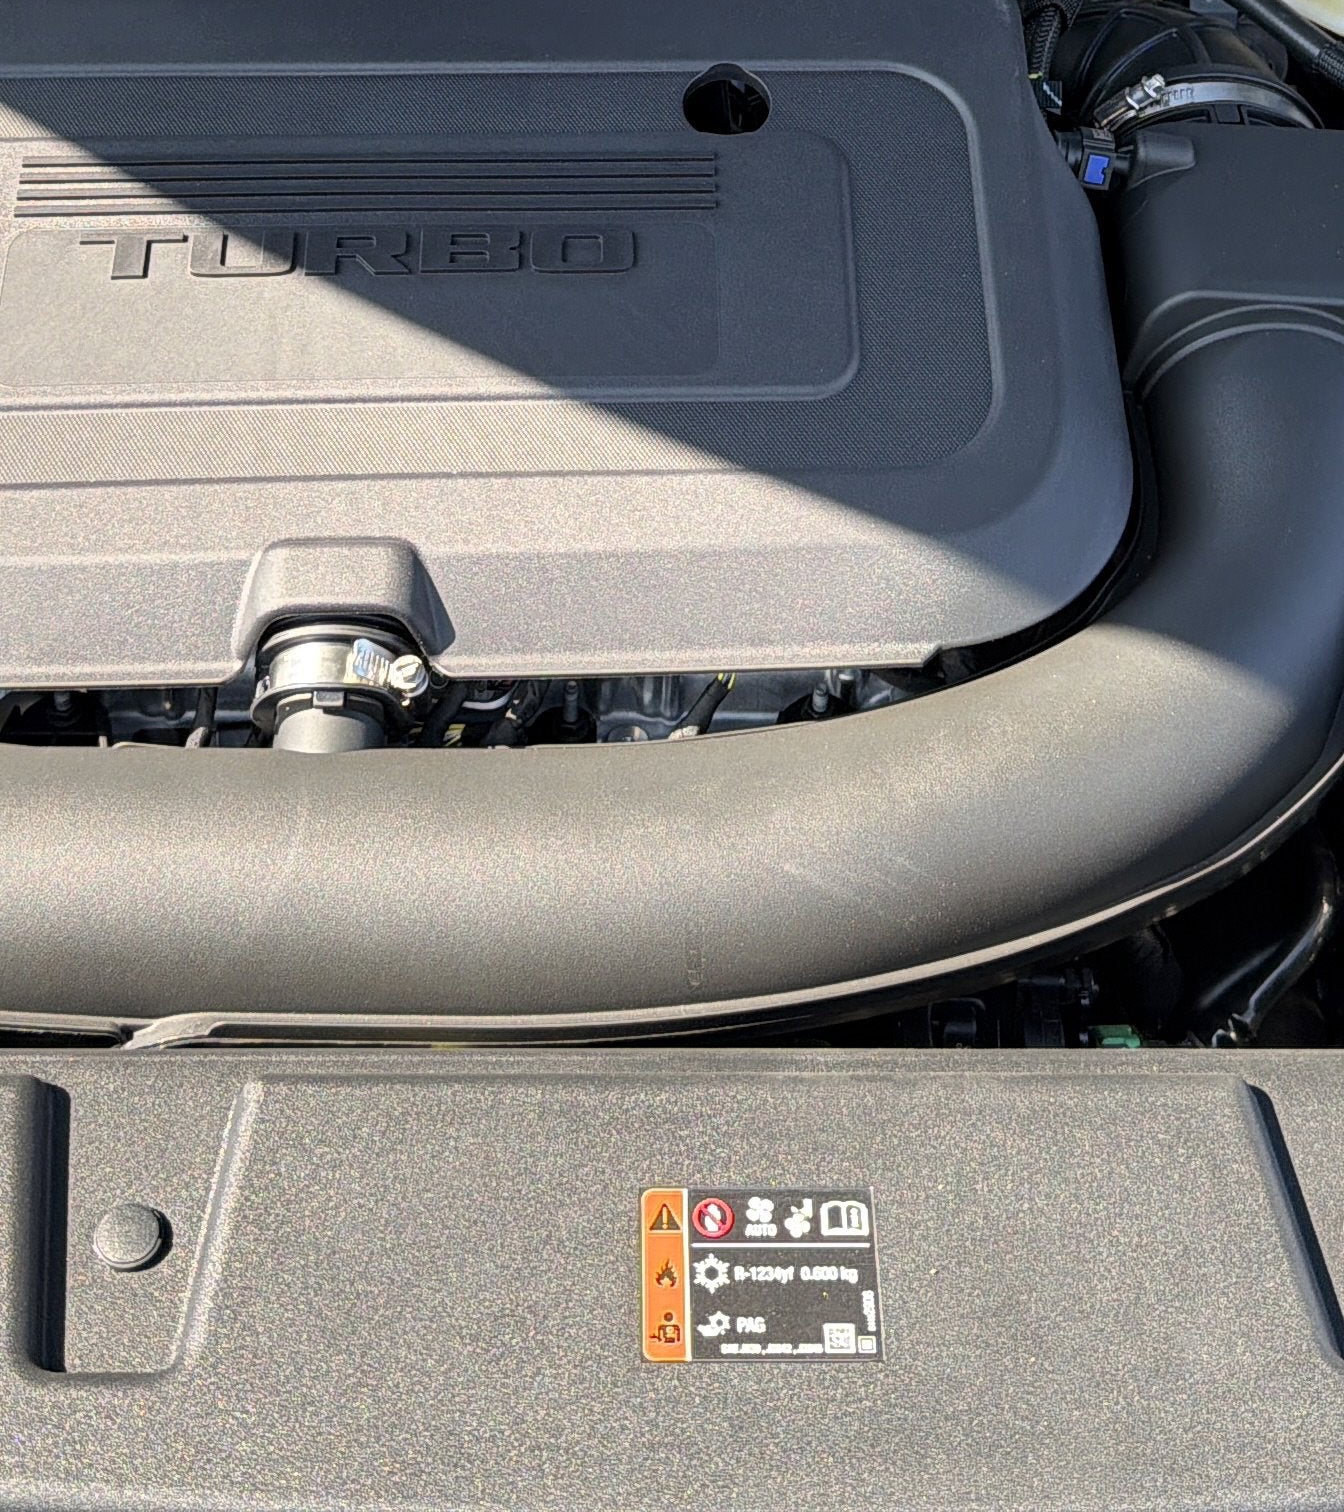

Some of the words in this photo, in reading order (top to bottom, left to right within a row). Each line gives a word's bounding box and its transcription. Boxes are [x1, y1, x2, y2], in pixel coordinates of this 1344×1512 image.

[79, 230, 635, 279] TURBO
[745, 1223, 777, 1237] AUTO
[737, 1317, 766, 1333] PAG
